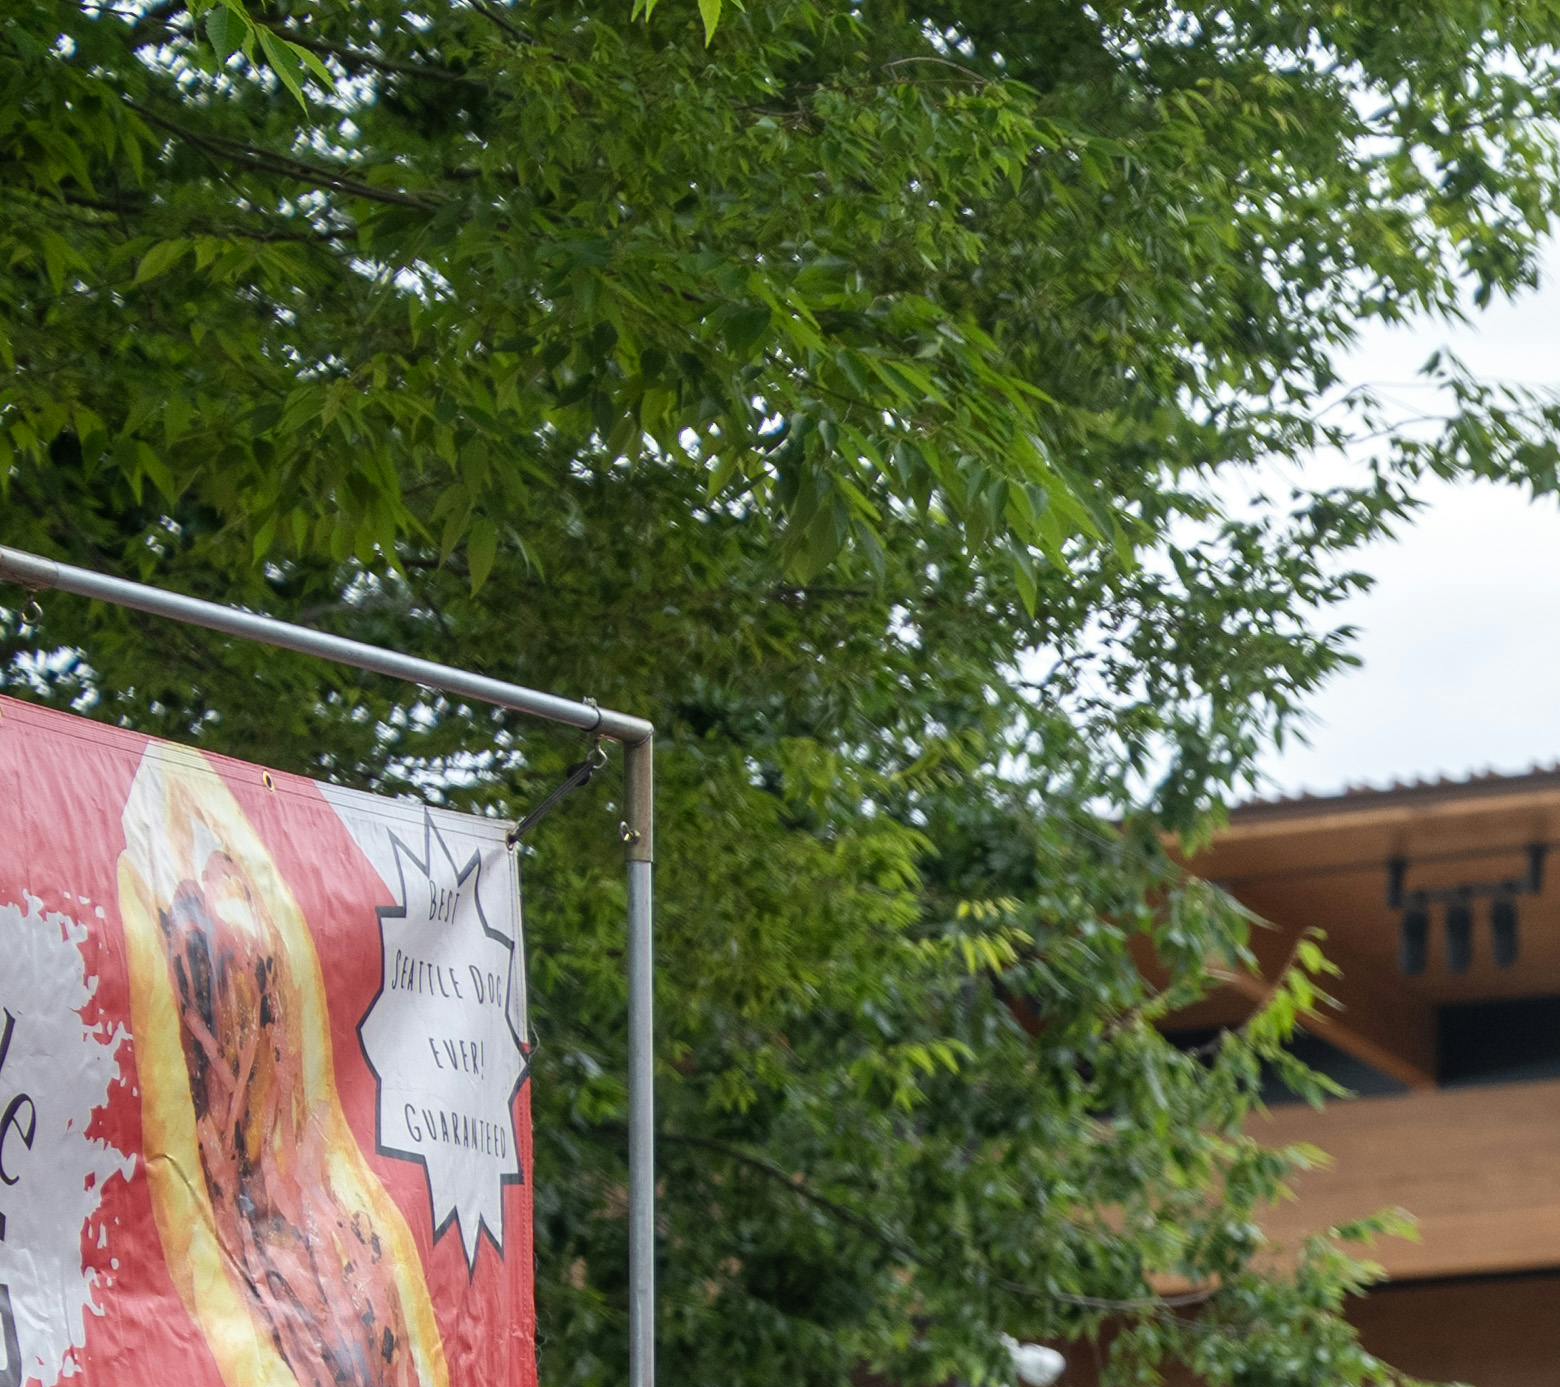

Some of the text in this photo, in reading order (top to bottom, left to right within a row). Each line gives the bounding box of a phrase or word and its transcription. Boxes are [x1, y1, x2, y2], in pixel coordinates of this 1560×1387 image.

[429, 880, 460, 925] BEST
[392, 949, 502, 1008] SEATTLE DOG
[429, 1038, 485, 1080] EVER!
[405, 1103, 506, 1159] GUARANTEED
